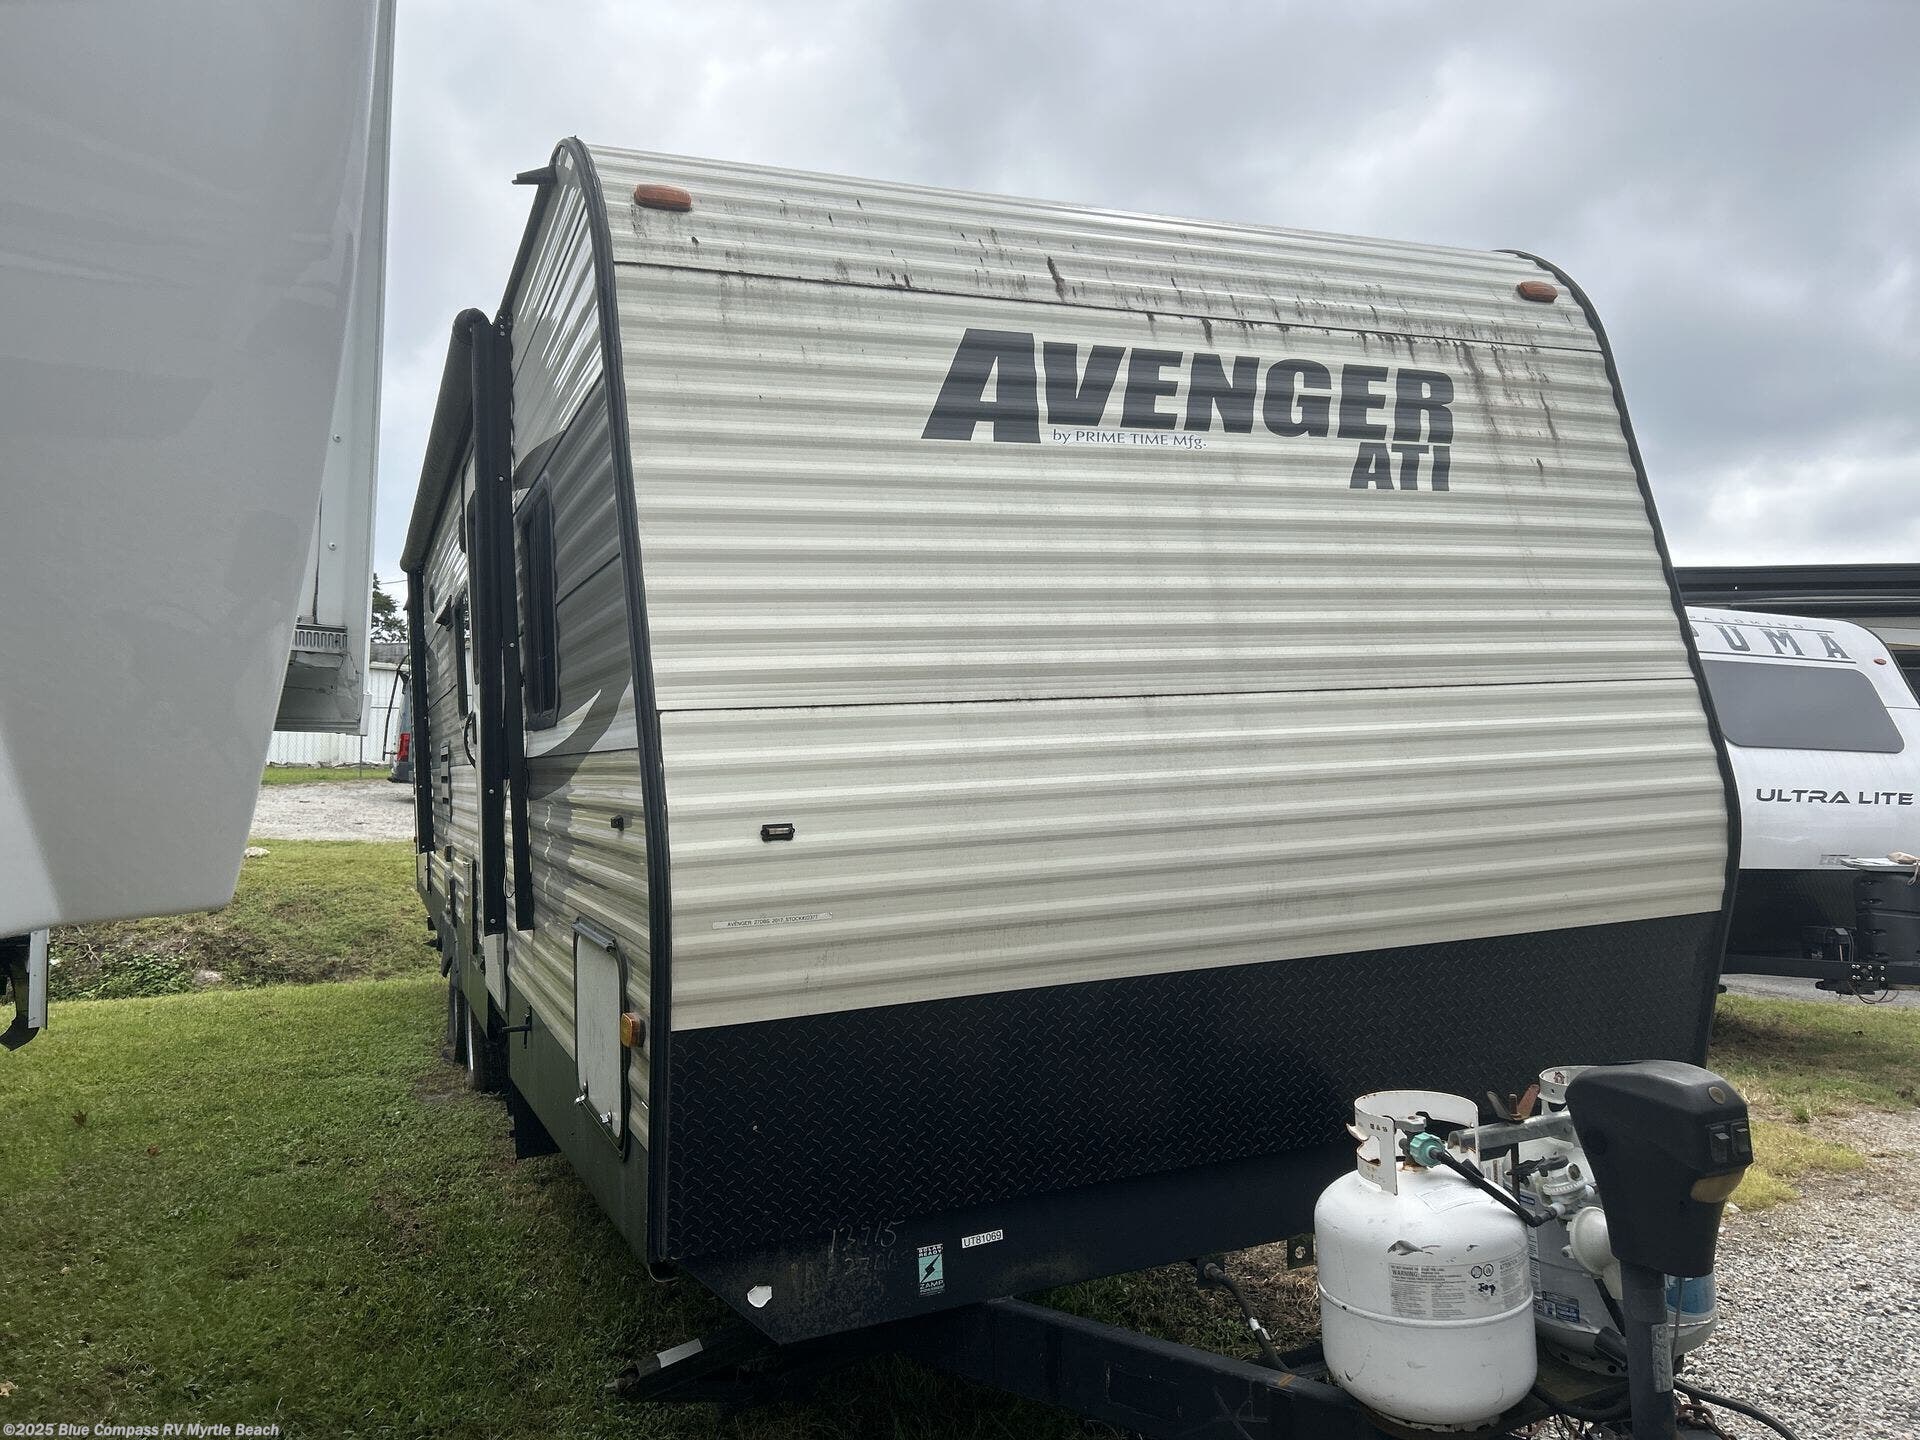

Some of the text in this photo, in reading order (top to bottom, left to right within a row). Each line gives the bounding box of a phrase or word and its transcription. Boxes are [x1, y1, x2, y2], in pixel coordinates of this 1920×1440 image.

[921, 328, 1454, 444] AVENGER
[1053, 429, 1071, 443] by
[1075, 430, 1125, 444] PRIME
[1129, 434, 1168, 446] TIME
[1350, 443, 1450, 491] ATI
[1690, 624, 1852, 660] UMA
[1756, 788, 1914, 806] ULTRA LITE
[963, 1230, 1002, 1247] UT81069
[918, 1249, 942, 1258] READY
[919, 1280, 944, 1290] ZAMP
